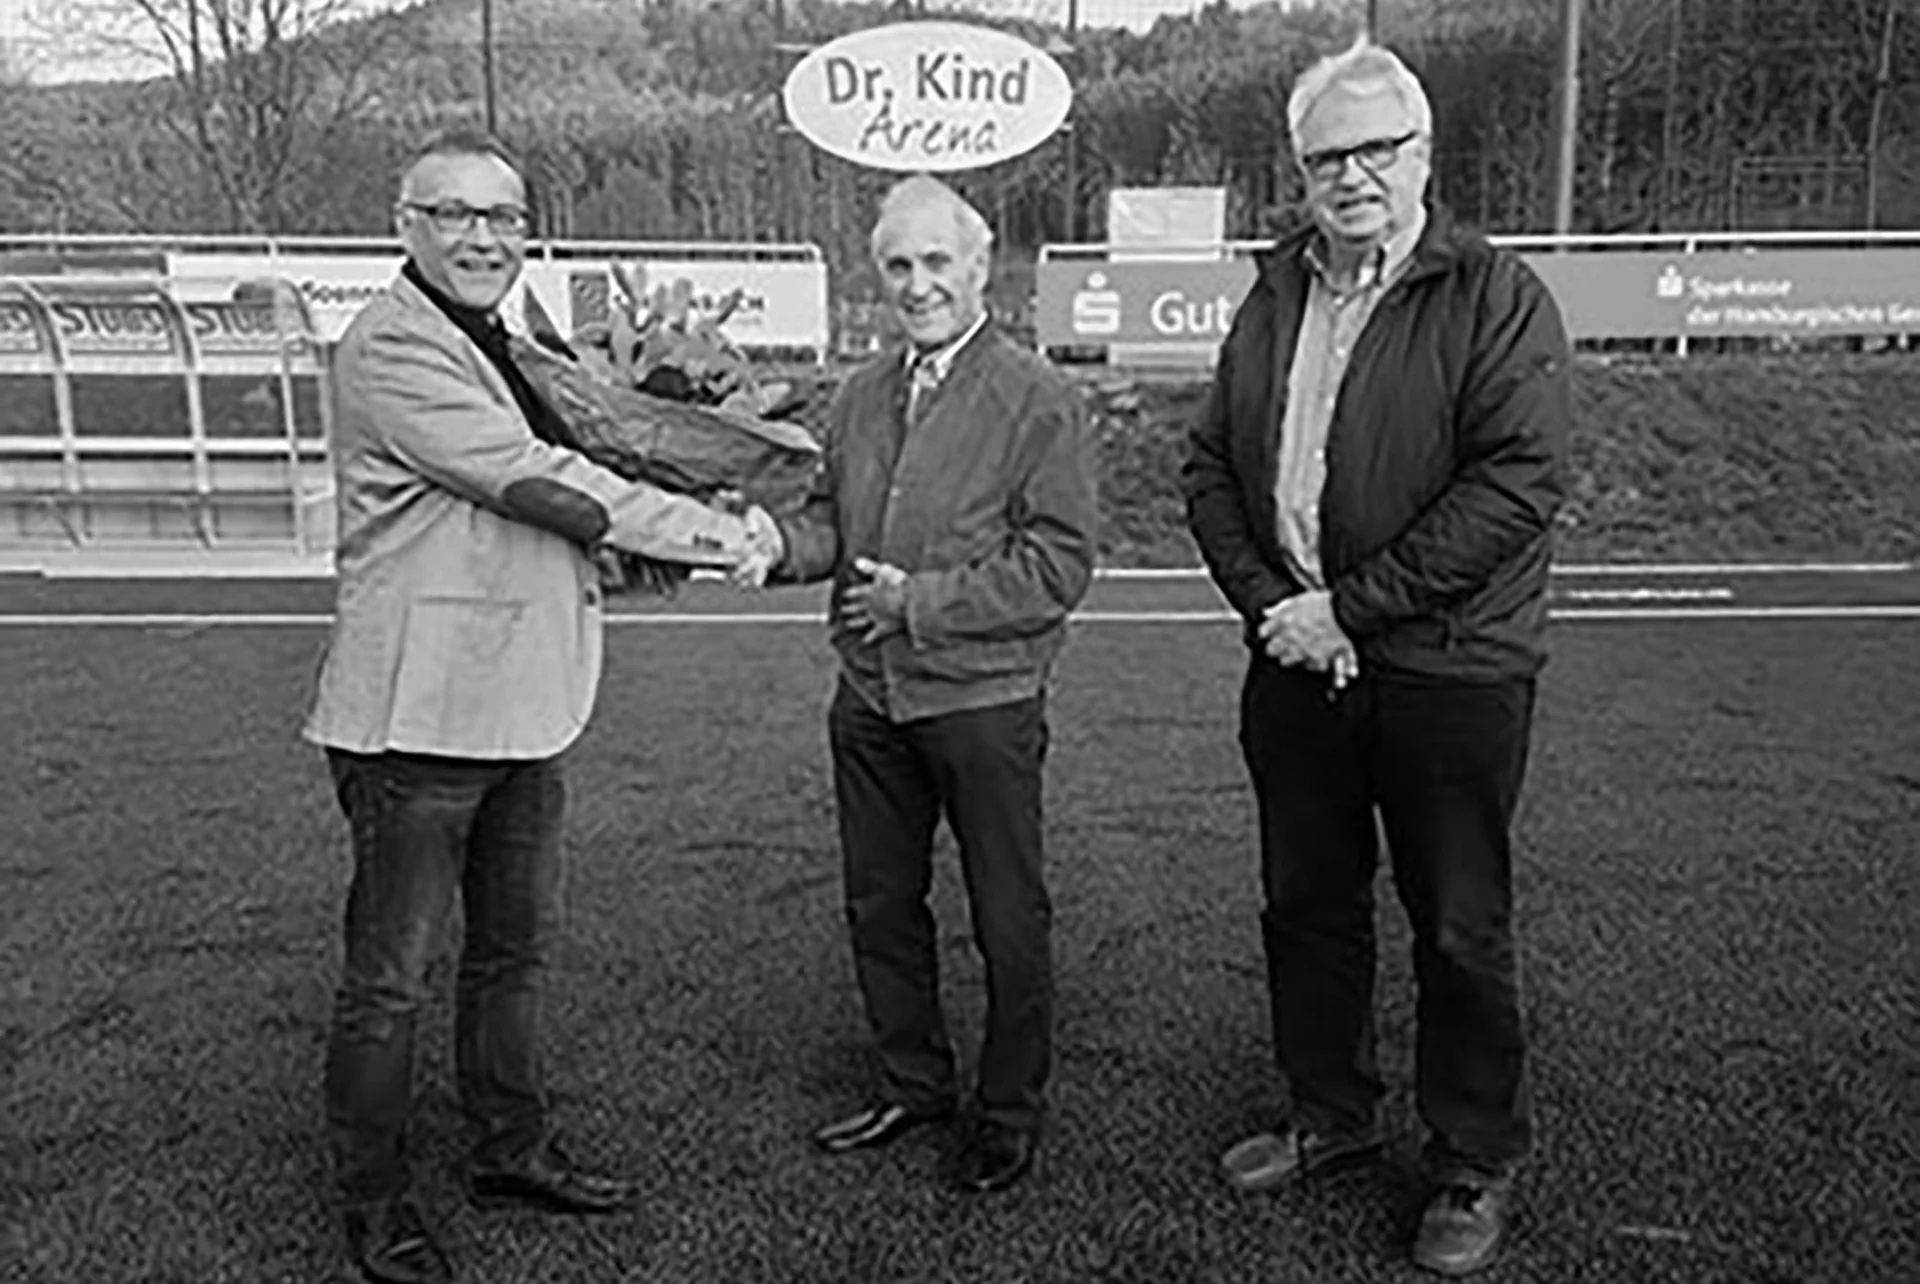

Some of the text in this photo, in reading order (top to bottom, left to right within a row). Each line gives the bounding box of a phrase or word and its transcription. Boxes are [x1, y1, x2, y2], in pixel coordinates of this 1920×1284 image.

[826, 53, 1029, 105] Dr. Kind
[859, 103, 997, 154] Arena
[1686, 304, 1720, 326] der
